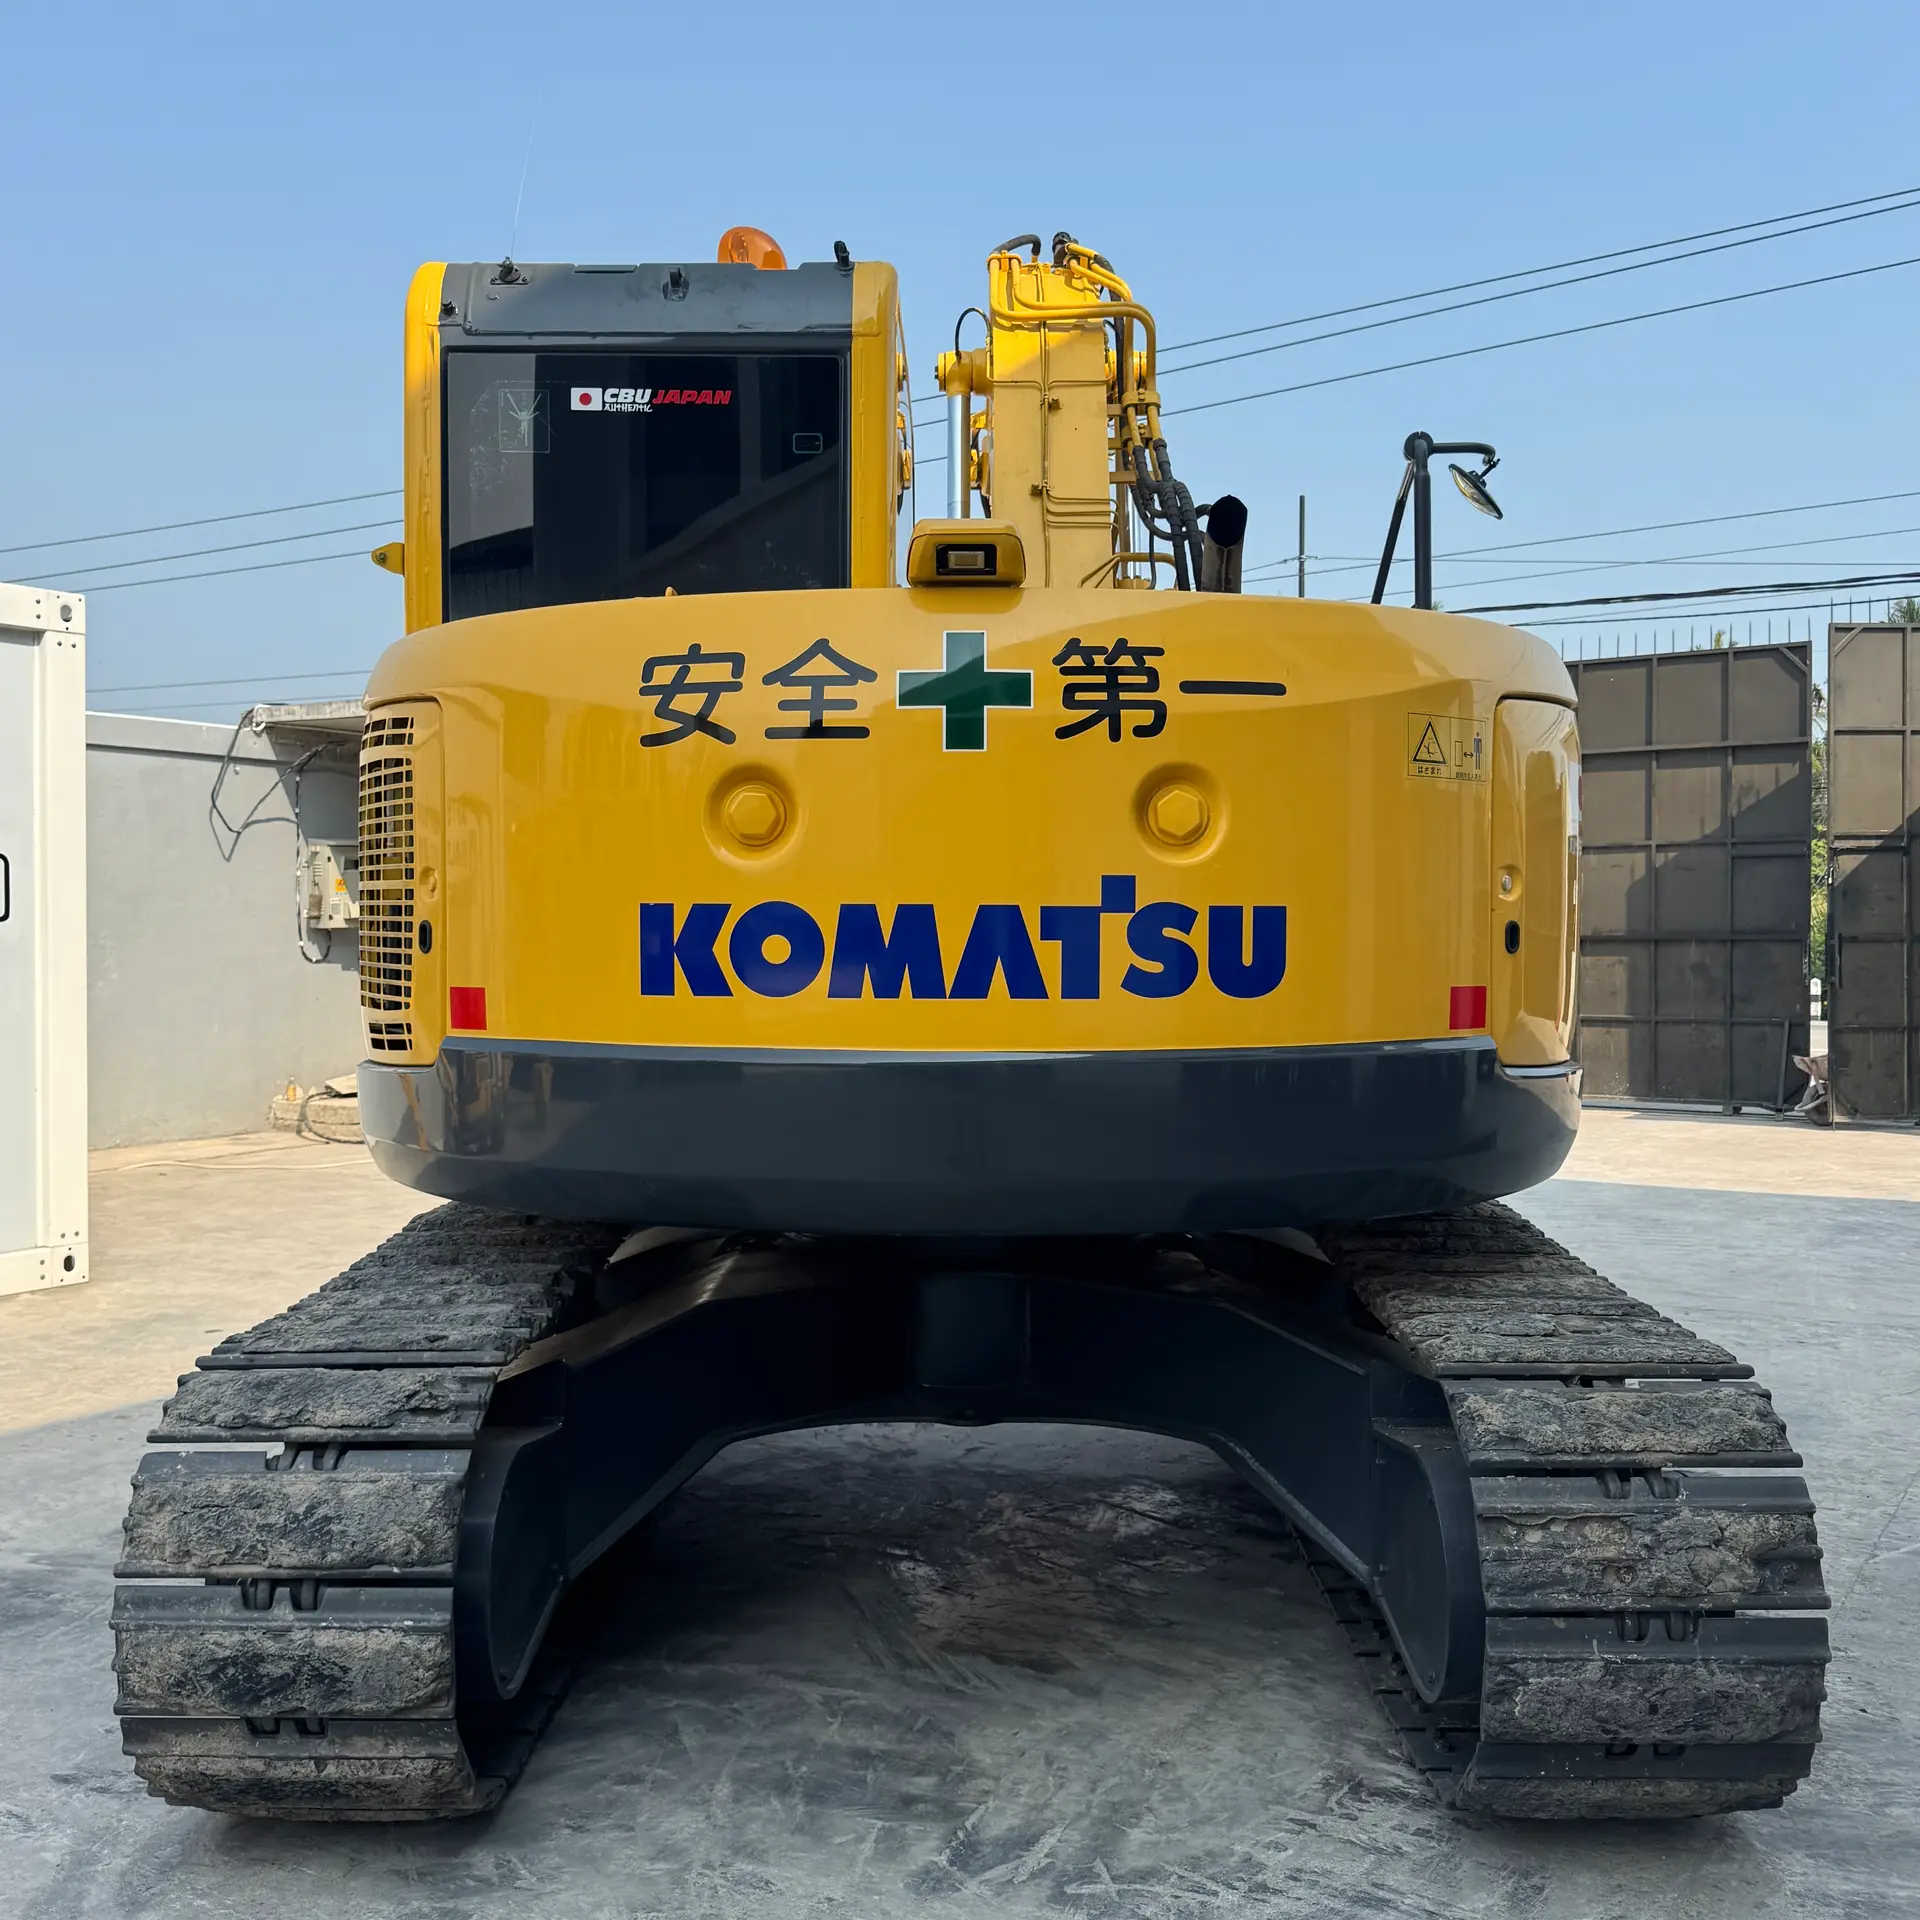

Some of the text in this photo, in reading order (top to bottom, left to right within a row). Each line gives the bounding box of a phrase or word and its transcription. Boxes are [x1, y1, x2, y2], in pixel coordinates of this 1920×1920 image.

[603, 387, 732, 405] CBU JAPAN
[639, 638, 1287, 748] 安全 第一
[640, 875, 1287, 1000] KOMATSU
